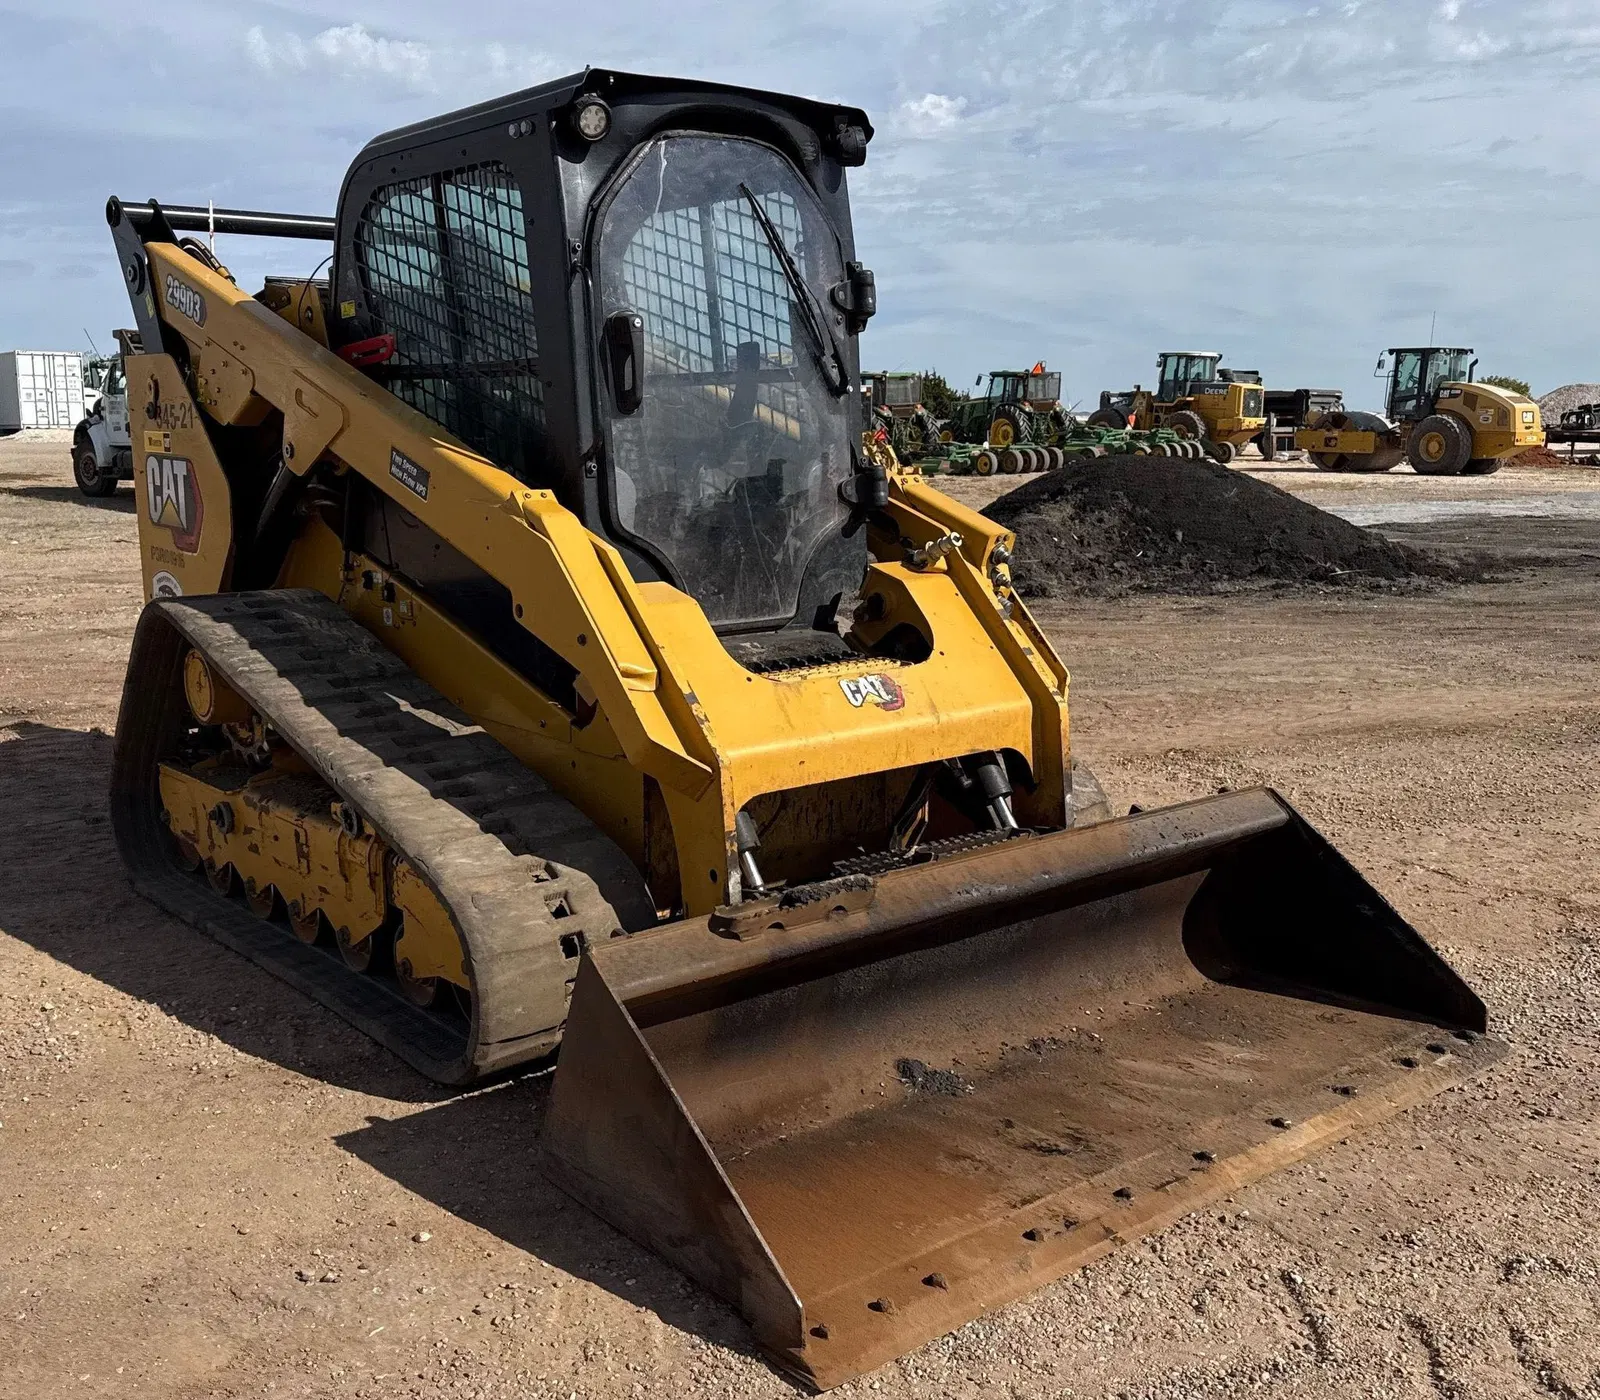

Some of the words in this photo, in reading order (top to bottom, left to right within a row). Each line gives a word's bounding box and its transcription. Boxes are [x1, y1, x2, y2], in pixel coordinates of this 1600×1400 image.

[166, 275, 201, 323] 299D3
[1204, 387, 1229, 395] DEERE
[1439, 389, 1450, 398] CAT
[402, 459, 418, 476] SPEED
[146, 456, 188, 529] CAT
[402, 472, 416, 488] FLOW
[415, 482, 427, 497] XPS
[838, 674, 895, 707] CAT
